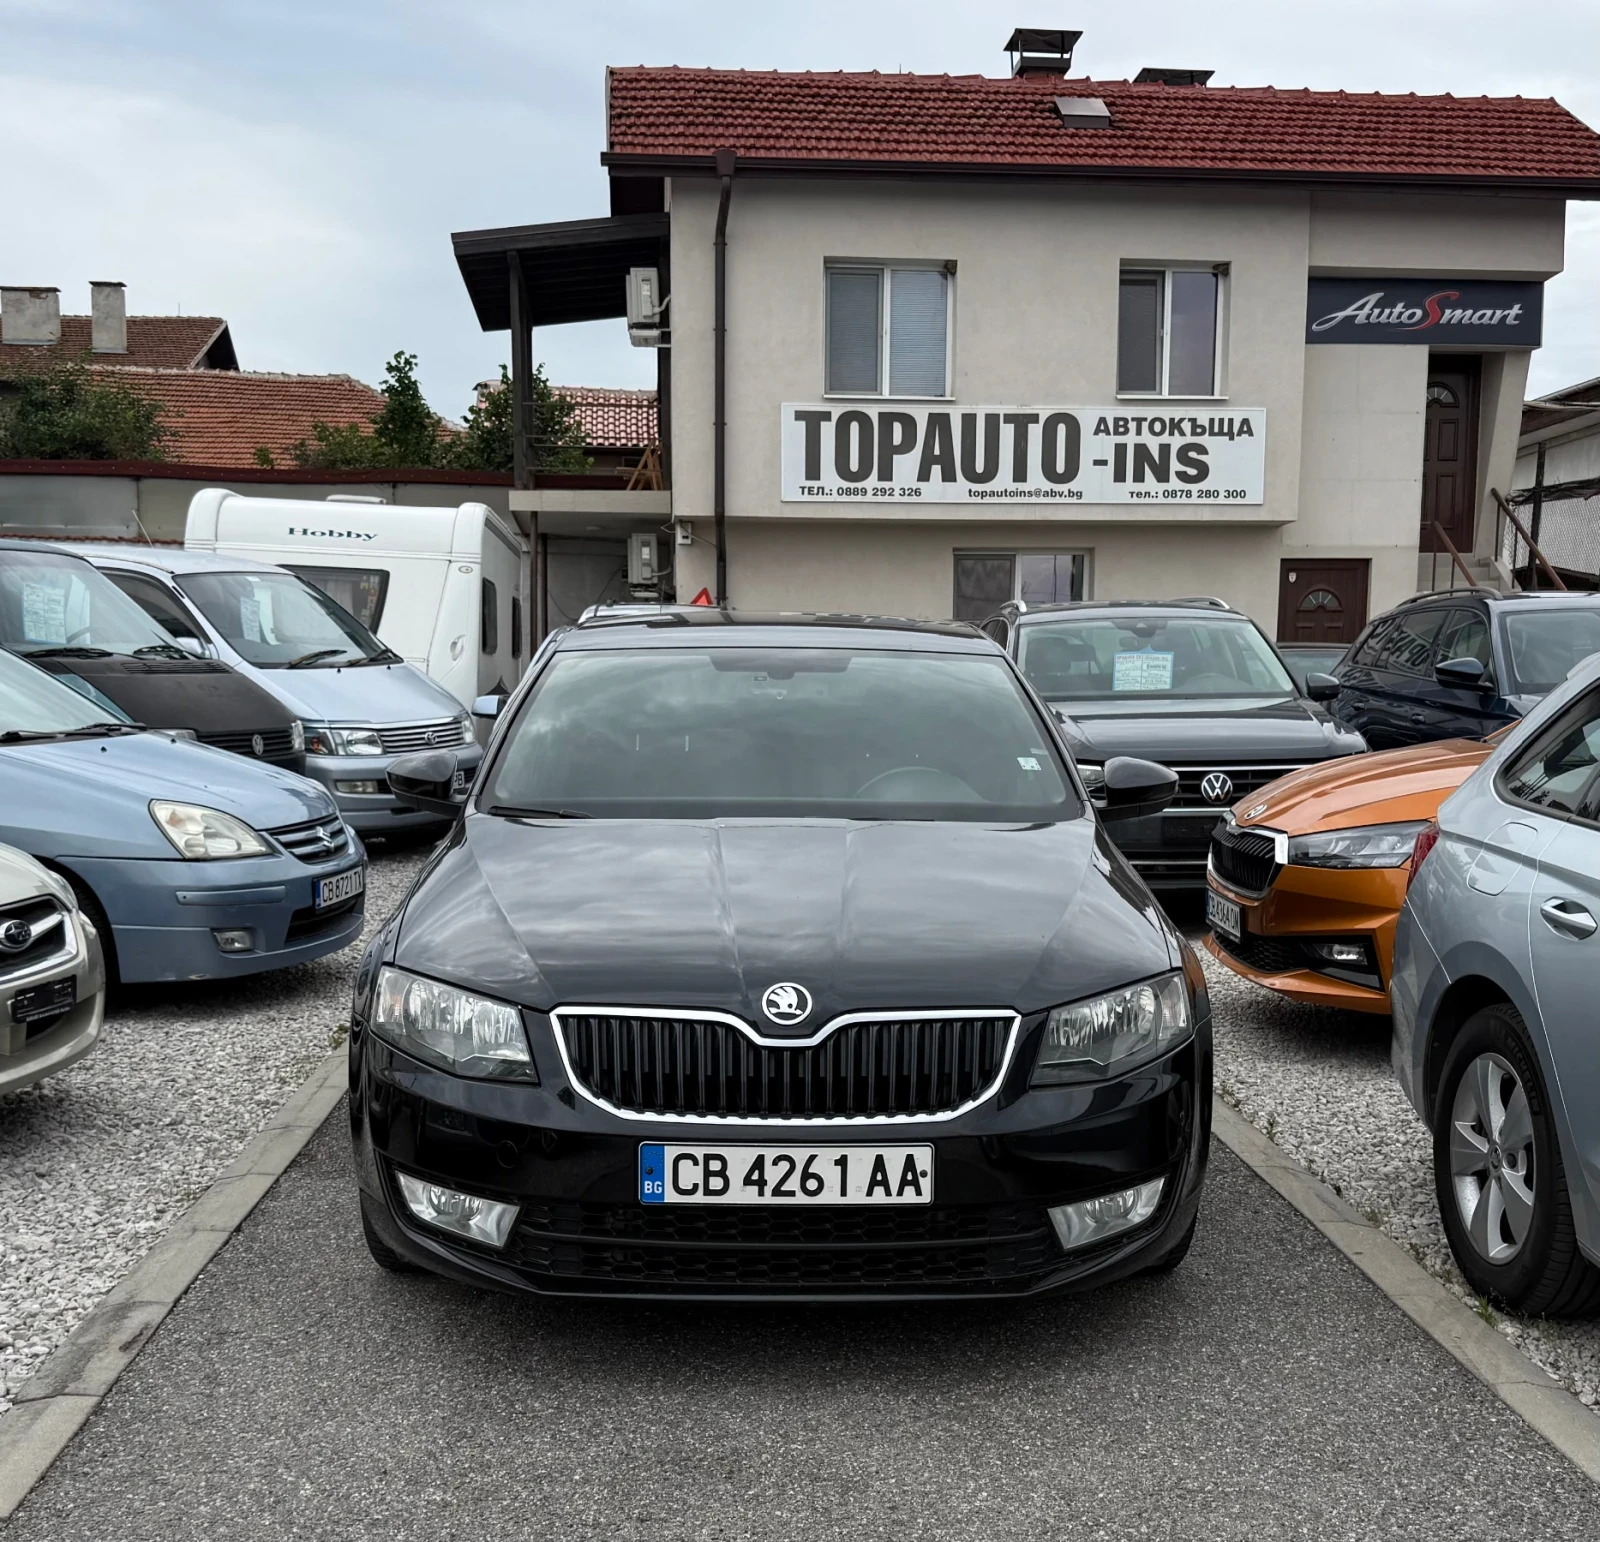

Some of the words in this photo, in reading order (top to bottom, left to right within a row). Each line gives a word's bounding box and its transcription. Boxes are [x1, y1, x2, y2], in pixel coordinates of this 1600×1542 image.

[1093, 416, 1255, 441] АВТОКЪЩА
[794, 410, 1081, 485] TOPAUTO
[799, 486, 832, 497] ТЕЛ.:
[837, 487, 868, 497] 0889
[872, 487, 895, 497] 292
[899, 488, 922, 497] 326
[968, 488, 1083, 500] topautoins@abv.bg
[1162, 490, 1193, 500] 0878
[1197, 490, 1220, 500] 280
[1223, 490, 1247, 500] 300
[288, 527, 379, 541] Hobby
[322, 881, 333, 902] CB
[335, 875, 352, 898] 8721
[644, 1181, 663, 1195] BG
[672, 1153, 731, 1197] CB
[743, 1154, 849, 1198] 4261
[865, 1153, 924, 1198] AA
